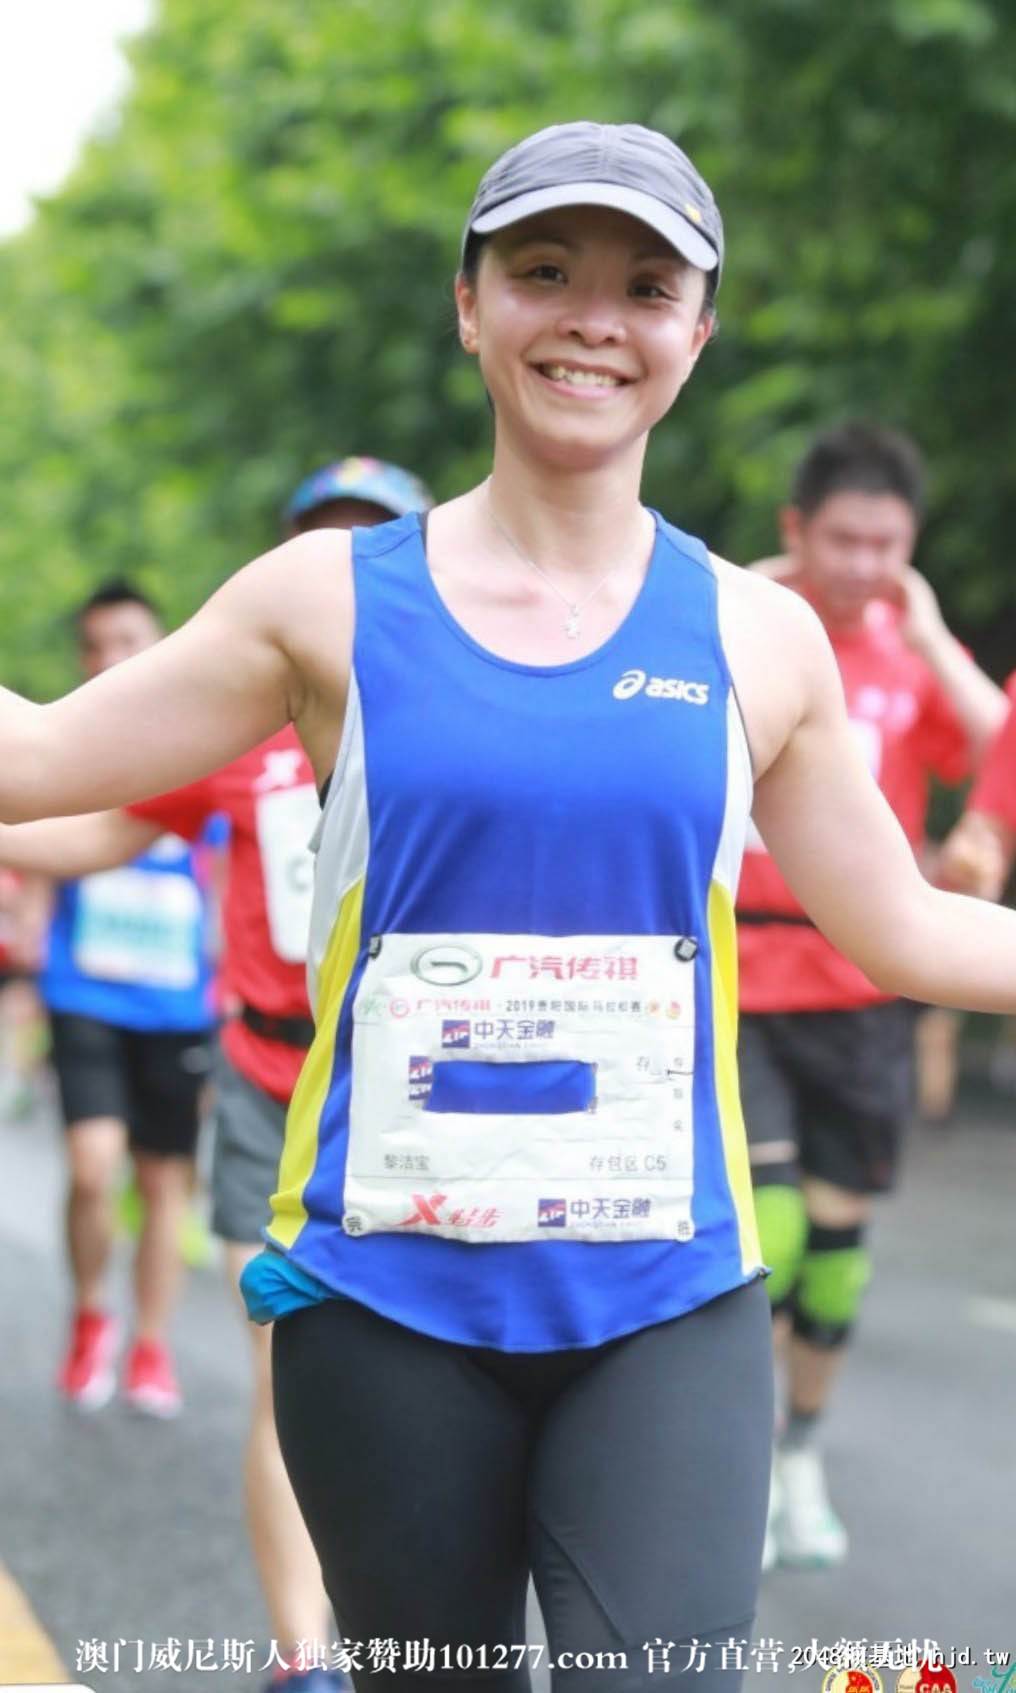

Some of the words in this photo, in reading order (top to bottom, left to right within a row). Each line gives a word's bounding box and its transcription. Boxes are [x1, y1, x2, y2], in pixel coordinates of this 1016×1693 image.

[645, 677, 710, 705] asics
[490, 955, 639, 981] 广汽传祺
[474, 1019, 556, 1041] 中天金融
[570, 1198, 652, 1219] 中天金融
